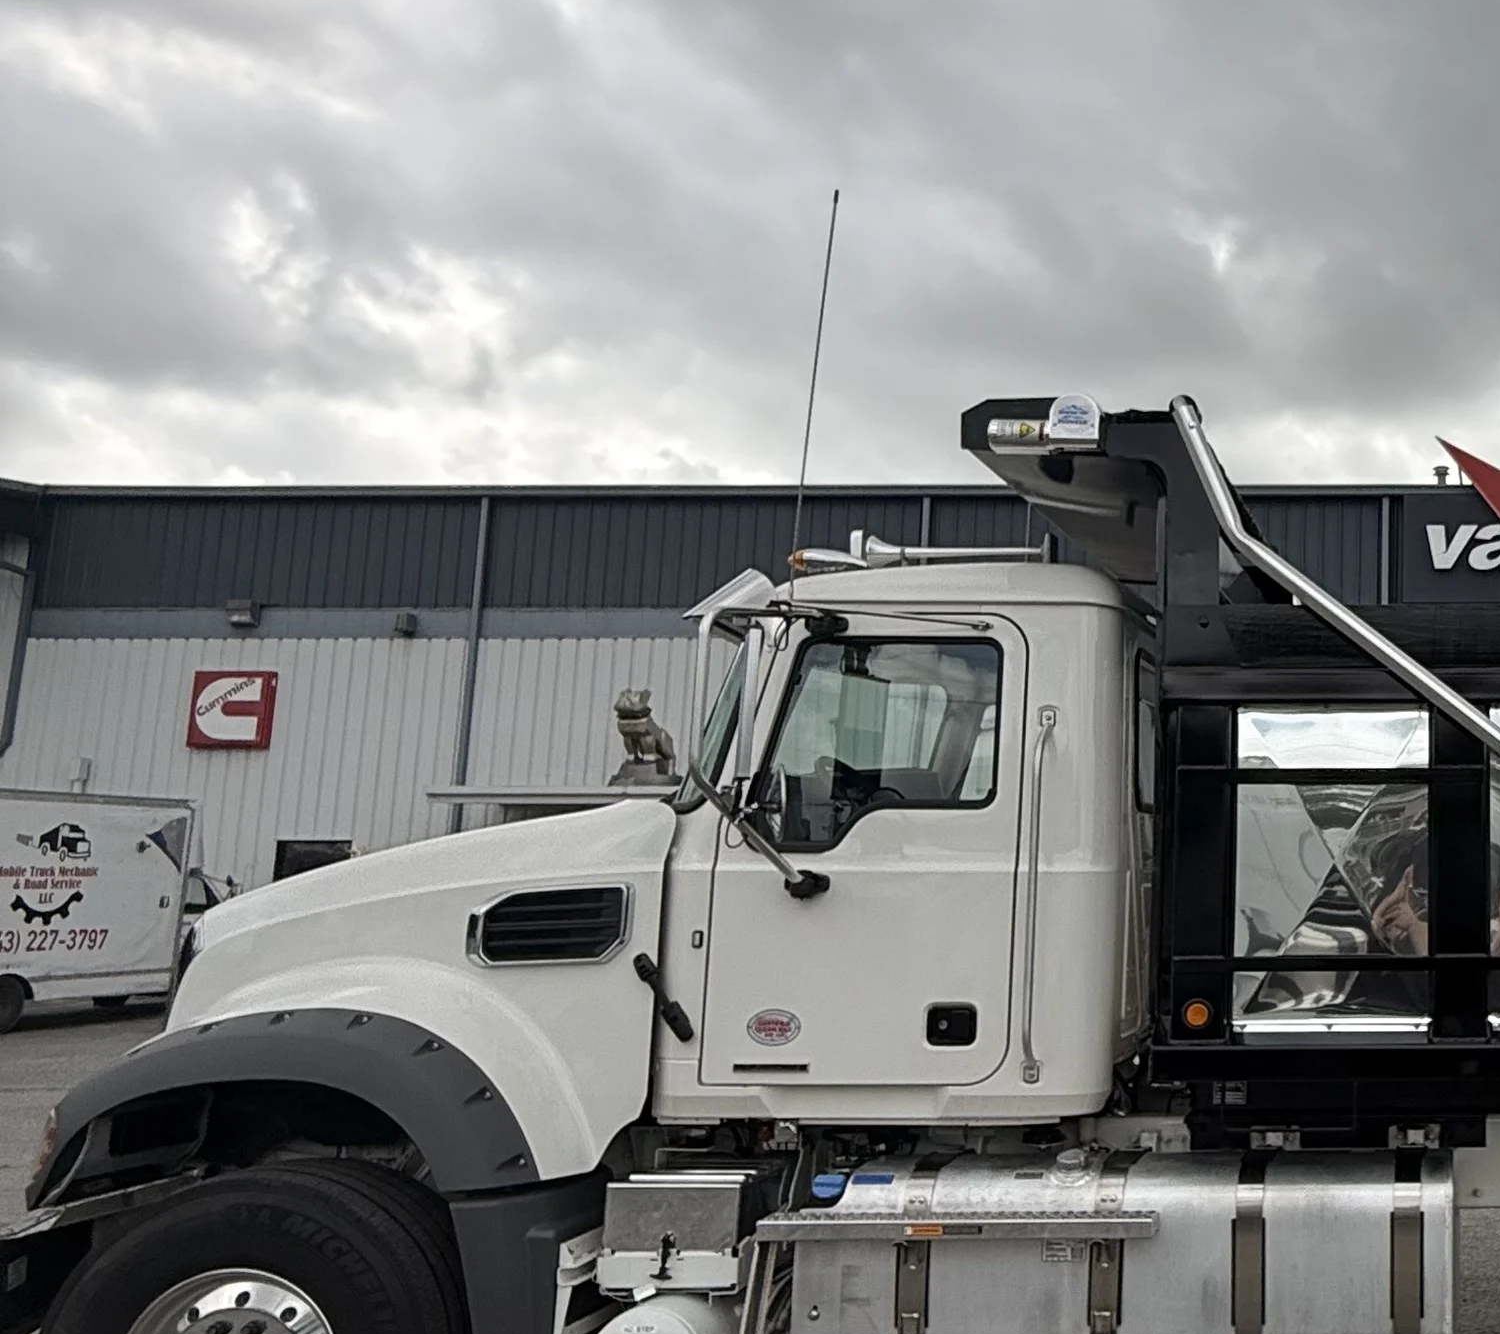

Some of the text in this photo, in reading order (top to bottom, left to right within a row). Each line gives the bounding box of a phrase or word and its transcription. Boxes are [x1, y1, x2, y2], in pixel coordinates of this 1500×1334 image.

[196, 678, 257, 717] Cummins
[29, 865, 55, 877] Truck
[58, 866, 99, 877] Mechanic
[13, 878, 82, 890] & Road Service
[38, 892, 55, 904] LLC
[0, 928, 109, 955] 3) 227-3797
